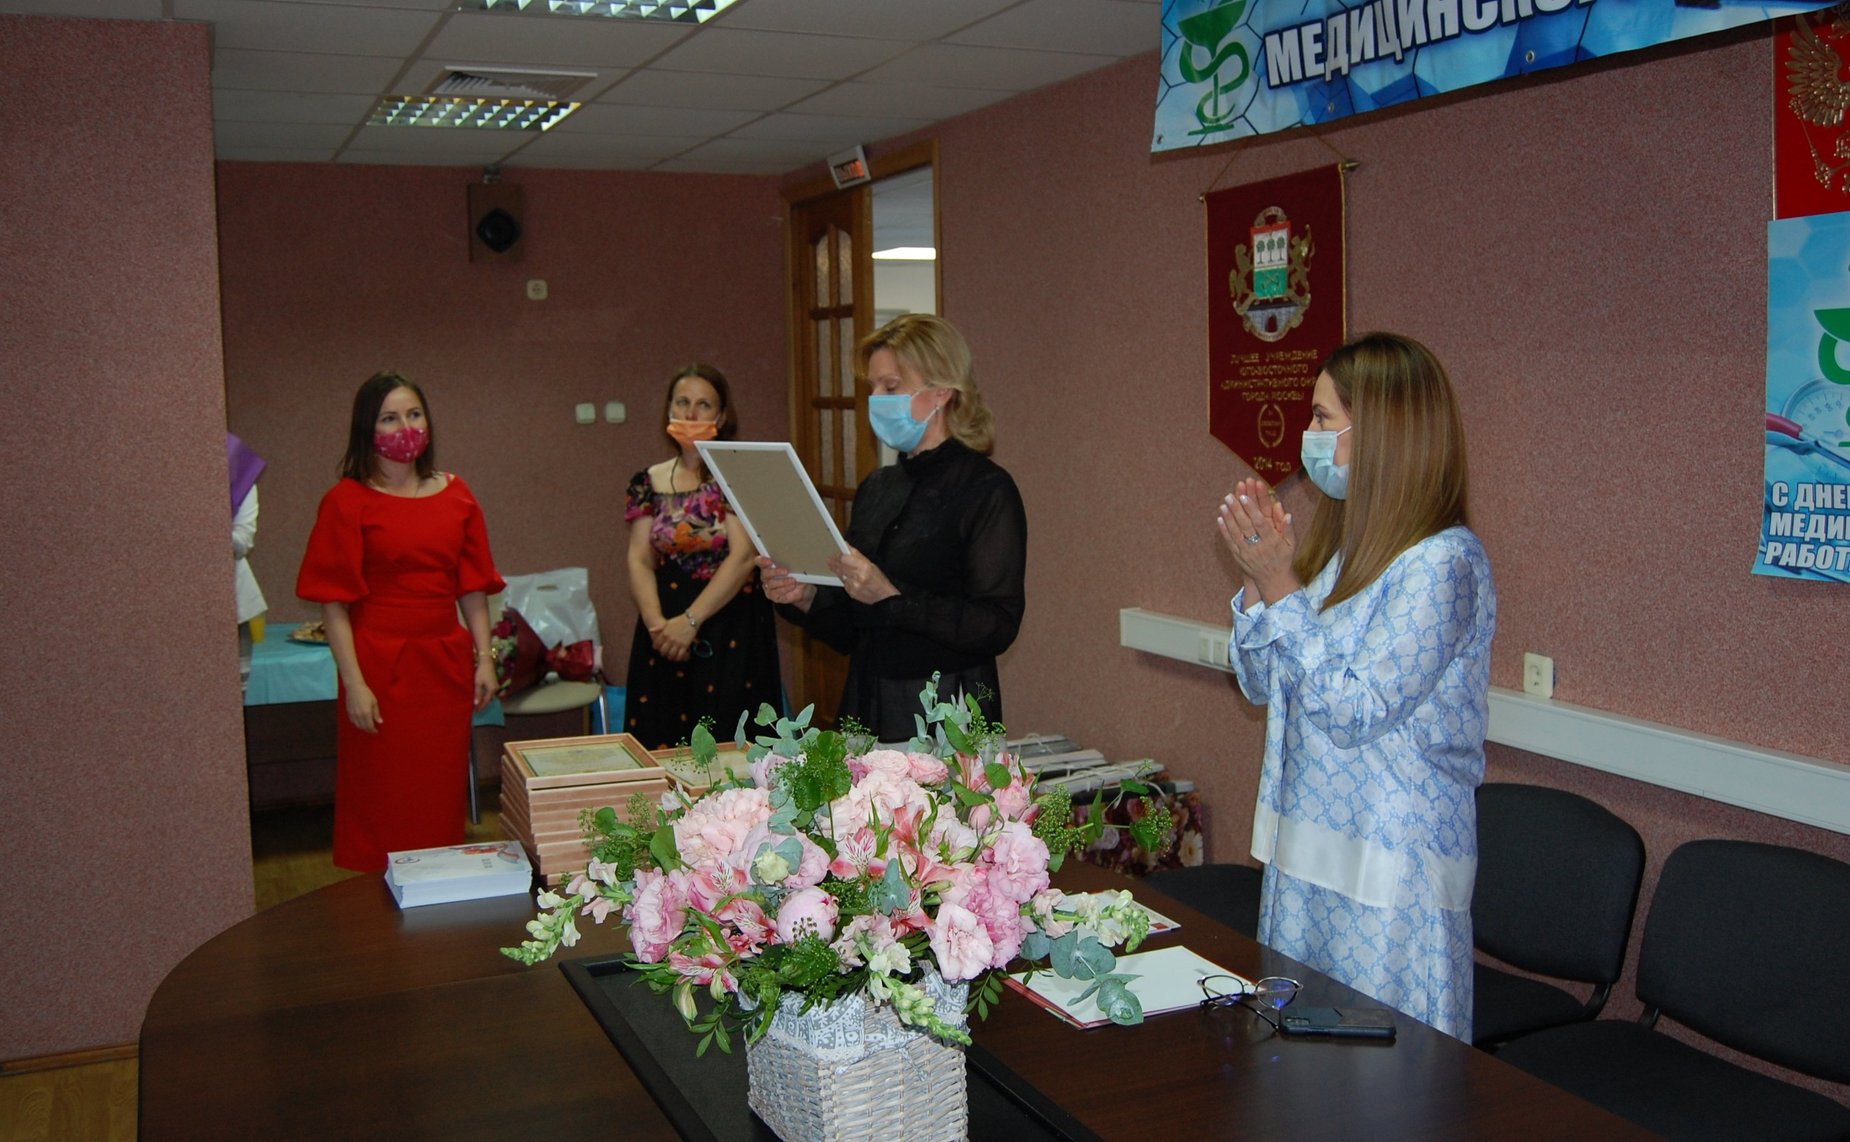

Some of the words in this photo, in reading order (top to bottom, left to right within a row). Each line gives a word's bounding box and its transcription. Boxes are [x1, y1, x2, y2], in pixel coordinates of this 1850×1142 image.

[1264, 0, 1596, 87] МЕДИЦИНС
[1771, 482, 1789, 507] С
[1793, 483, 1850, 512] ДНЕ
[1769, 512, 1850, 542] МЕДИ
[1764, 541, 1850, 570] РАБОТ
